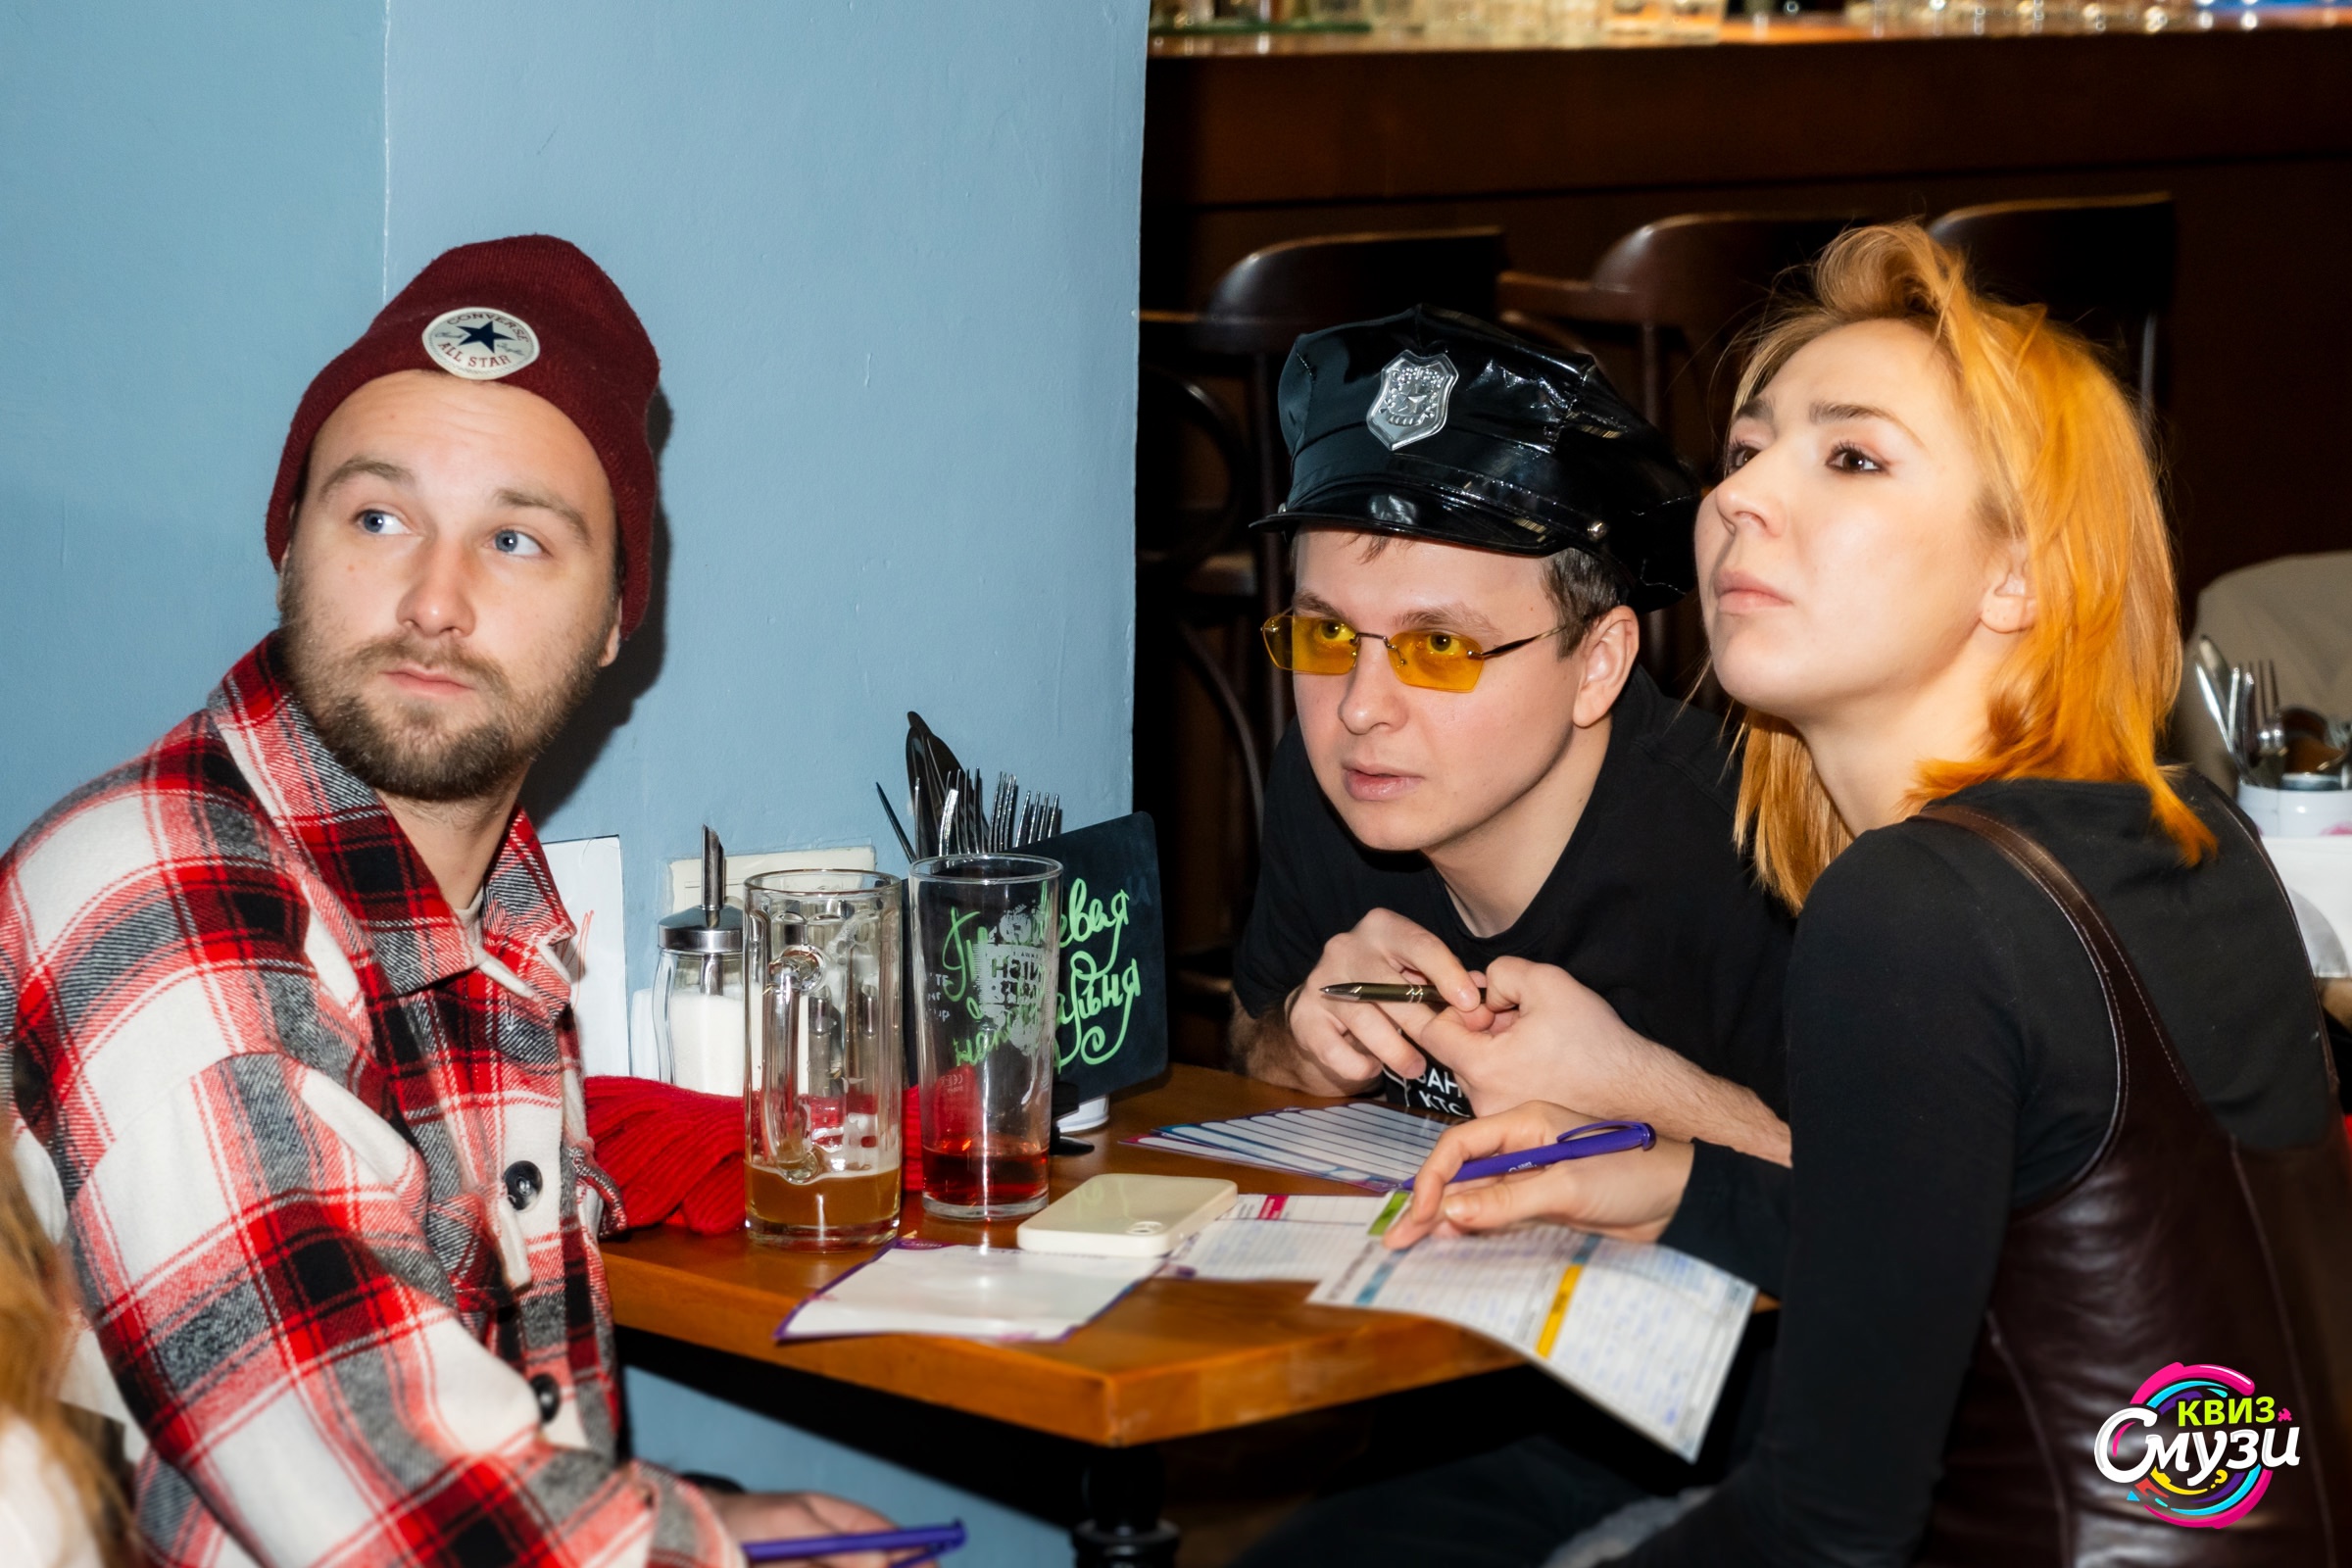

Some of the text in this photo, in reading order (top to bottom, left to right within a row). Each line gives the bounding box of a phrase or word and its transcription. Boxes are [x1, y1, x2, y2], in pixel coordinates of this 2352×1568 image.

[446, 312, 530, 342] CONVERSE
[438, 341, 512, 368] ALL STAR
